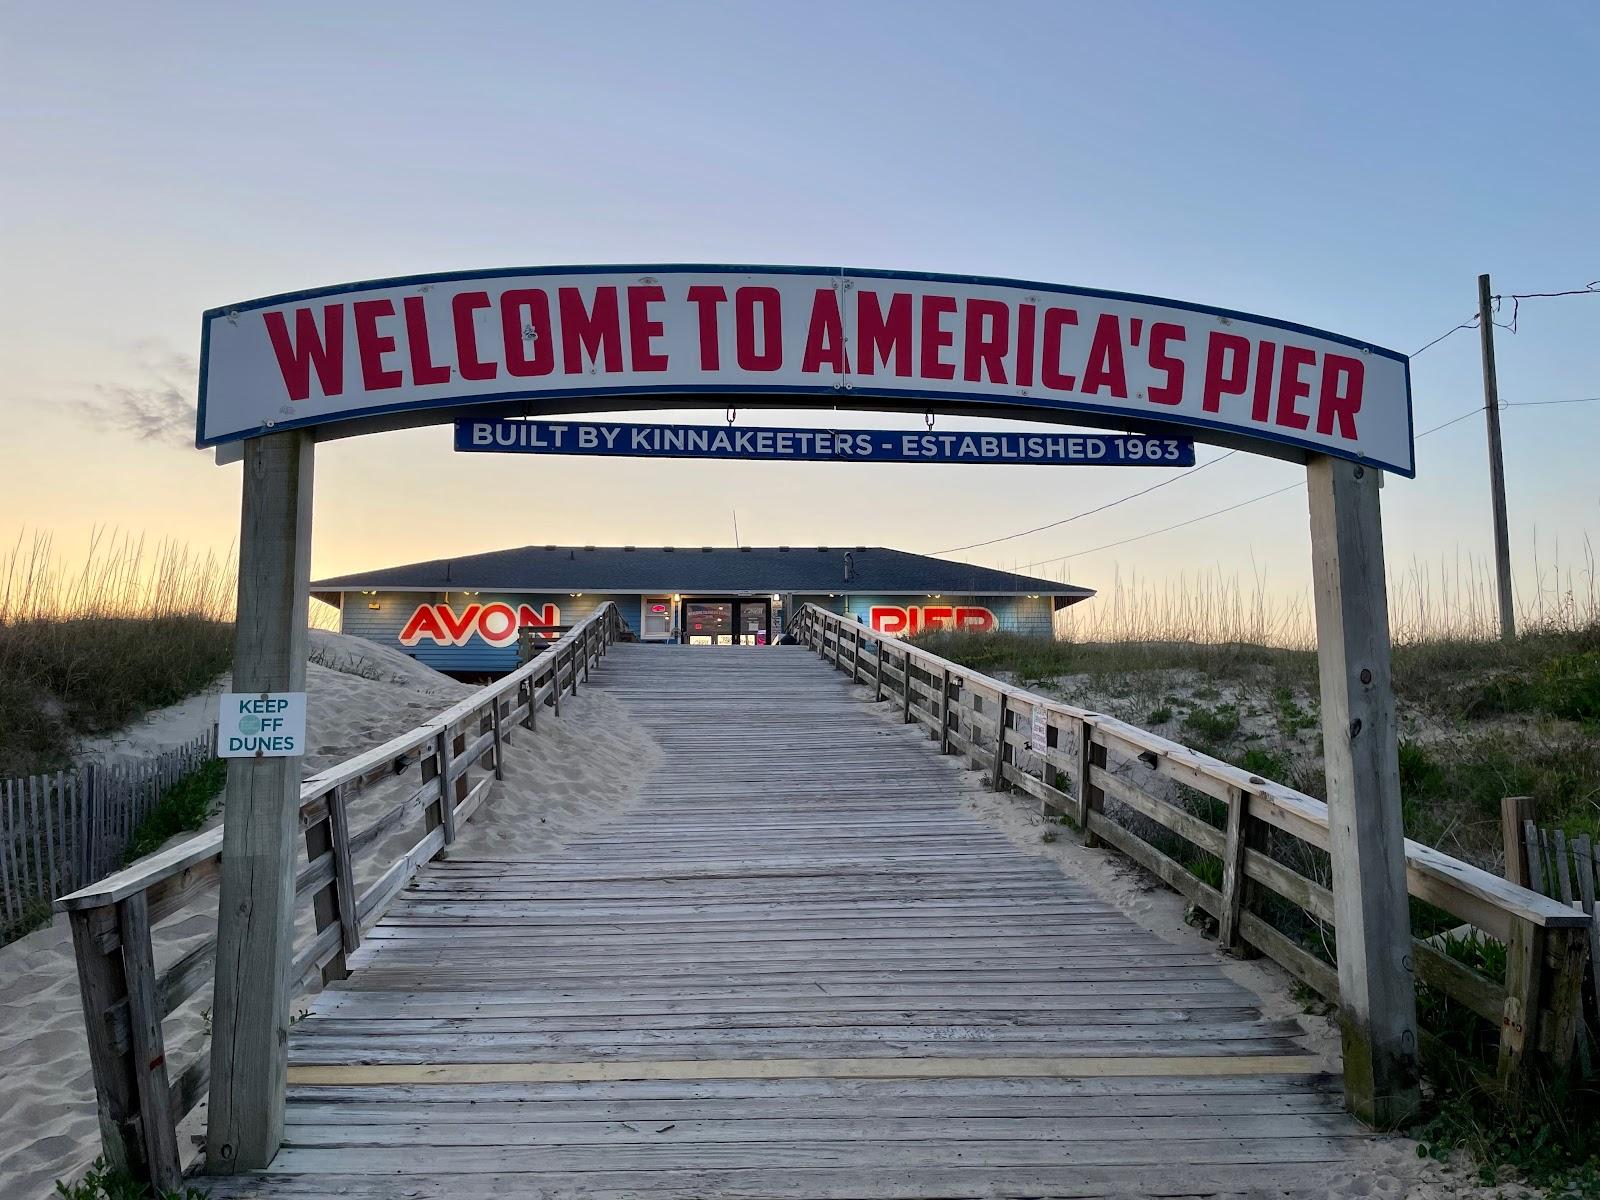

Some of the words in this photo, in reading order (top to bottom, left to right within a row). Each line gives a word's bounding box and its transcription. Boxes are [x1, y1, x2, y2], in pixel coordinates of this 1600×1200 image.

[263, 286, 669, 400] WELCOME
[687, 286, 783, 371] TO
[802, 288, 1187, 405] AMERICA'S
[1203, 331, 1365, 440] PIER
[472, 423, 568, 447] BUILT
[578, 426, 622, 449] BY
[631, 428, 873, 455] KINNAKEETERS
[902, 435, 1106, 459] ESTABLISHED
[1115, 438, 1180, 460] 1963
[399, 602, 560, 646] AVON
[239, 699, 289, 714] KEEP
[229, 736, 294, 752] DUNES
